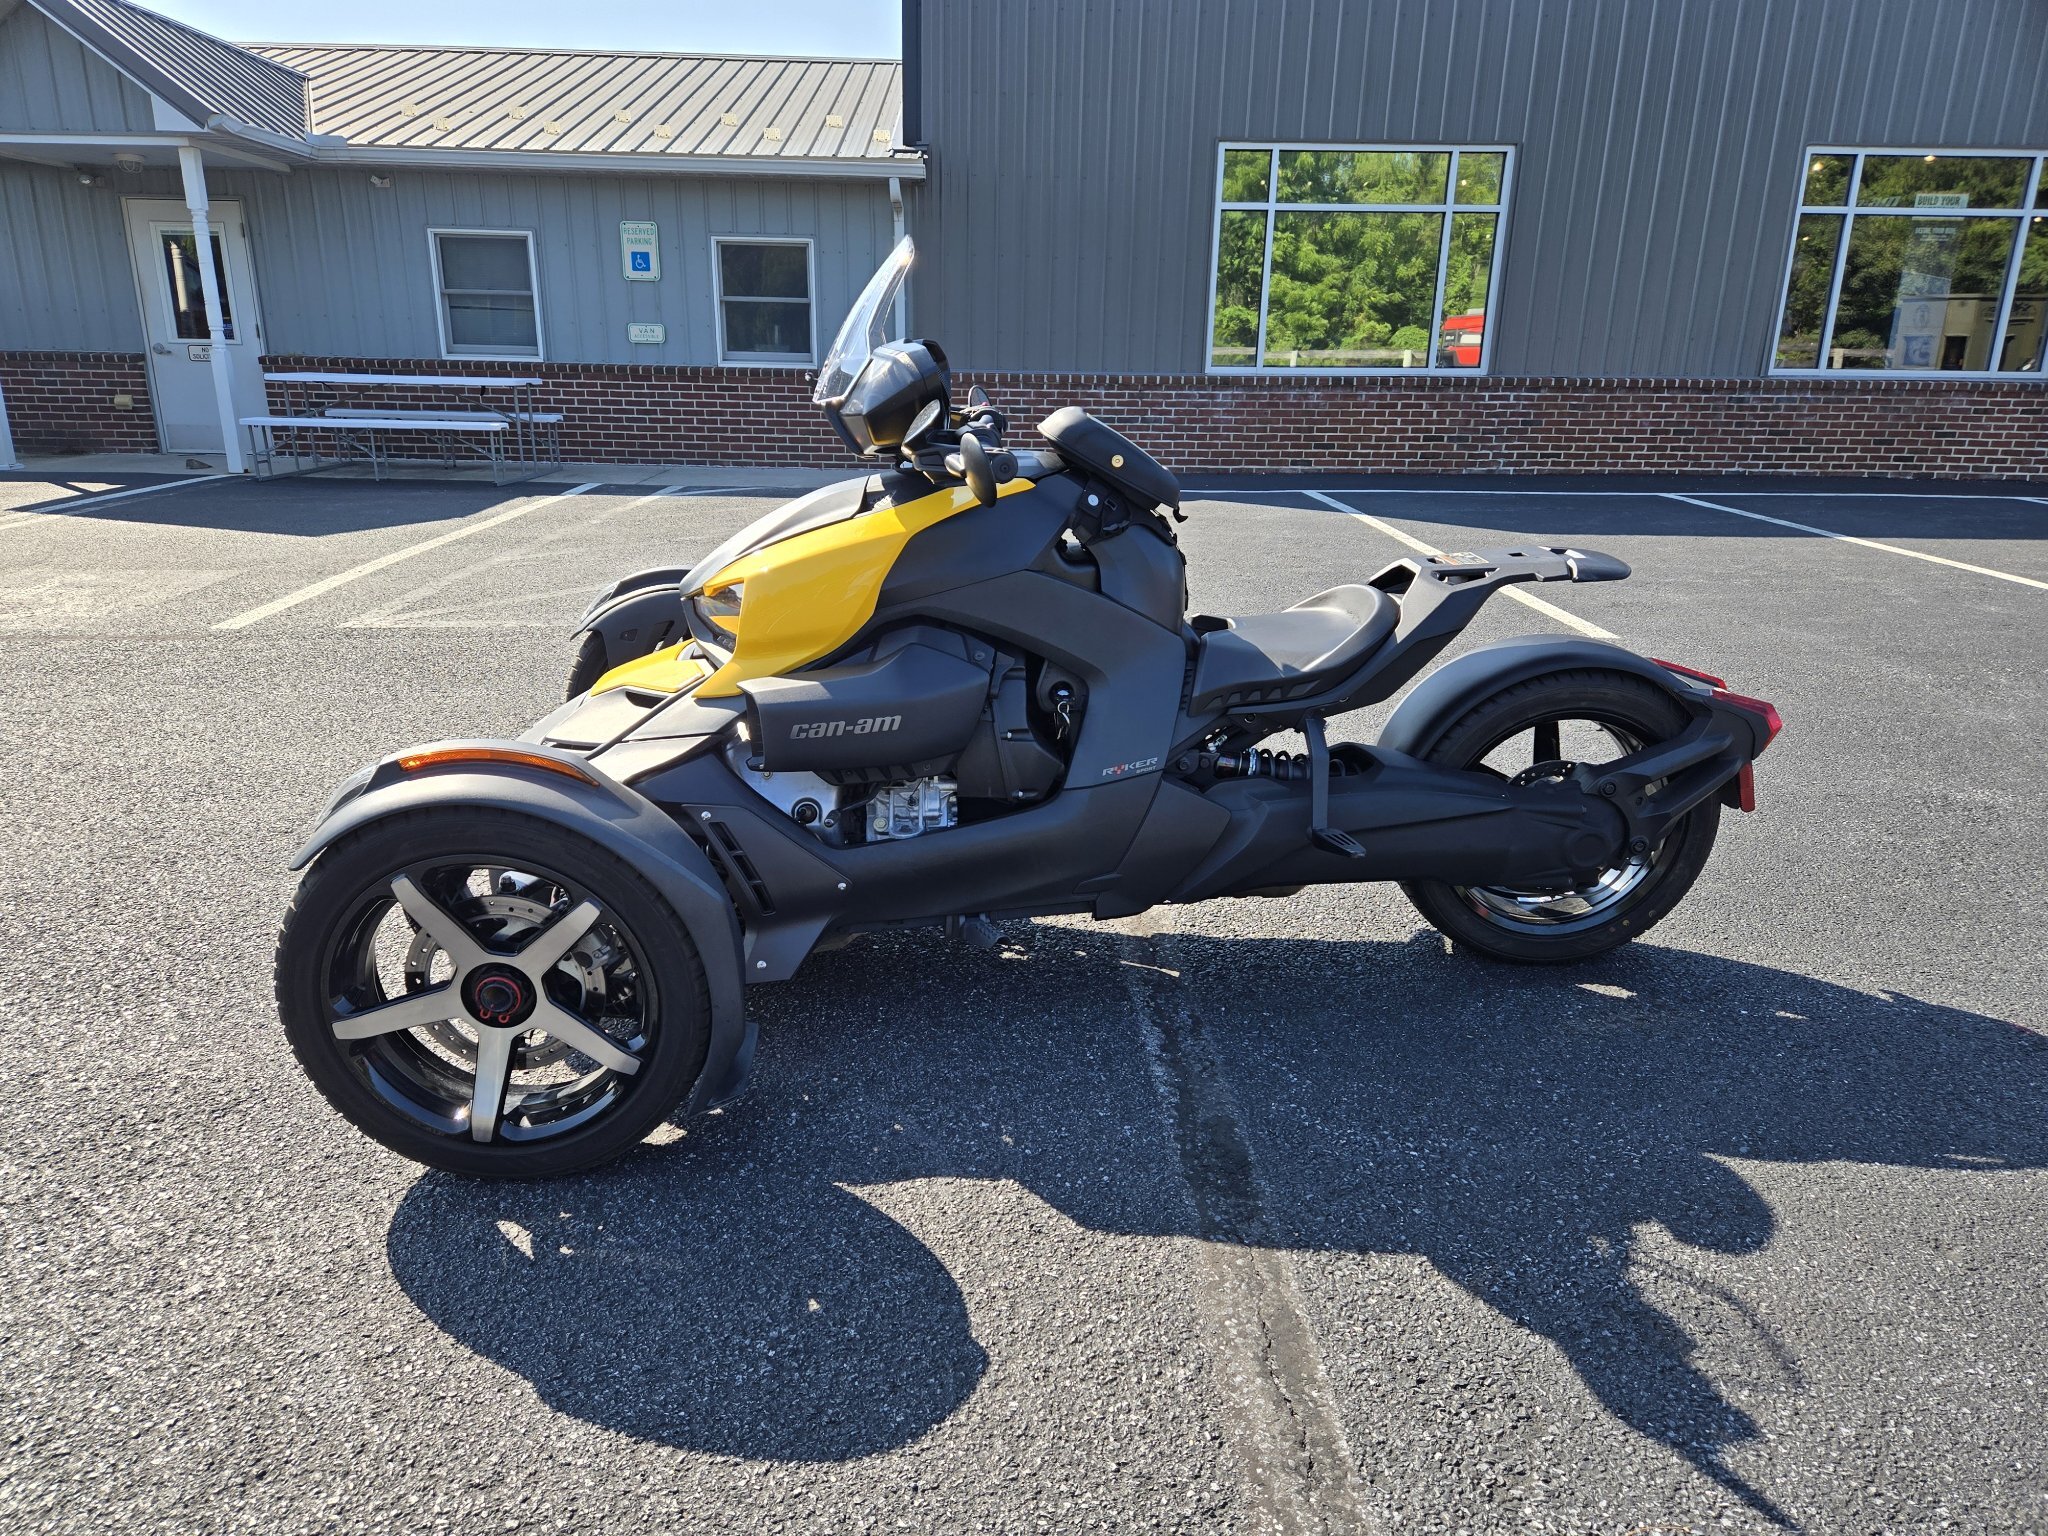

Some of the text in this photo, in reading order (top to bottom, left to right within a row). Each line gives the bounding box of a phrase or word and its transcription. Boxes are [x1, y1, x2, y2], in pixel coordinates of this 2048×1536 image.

[1917, 195, 1961, 206] BUILD YOUR
[623, 227, 656, 236] RESERVED
[626, 237, 653, 246] PARKING
[790, 715, 902, 739] can-am
[1102, 757, 1158, 776] RYKER
